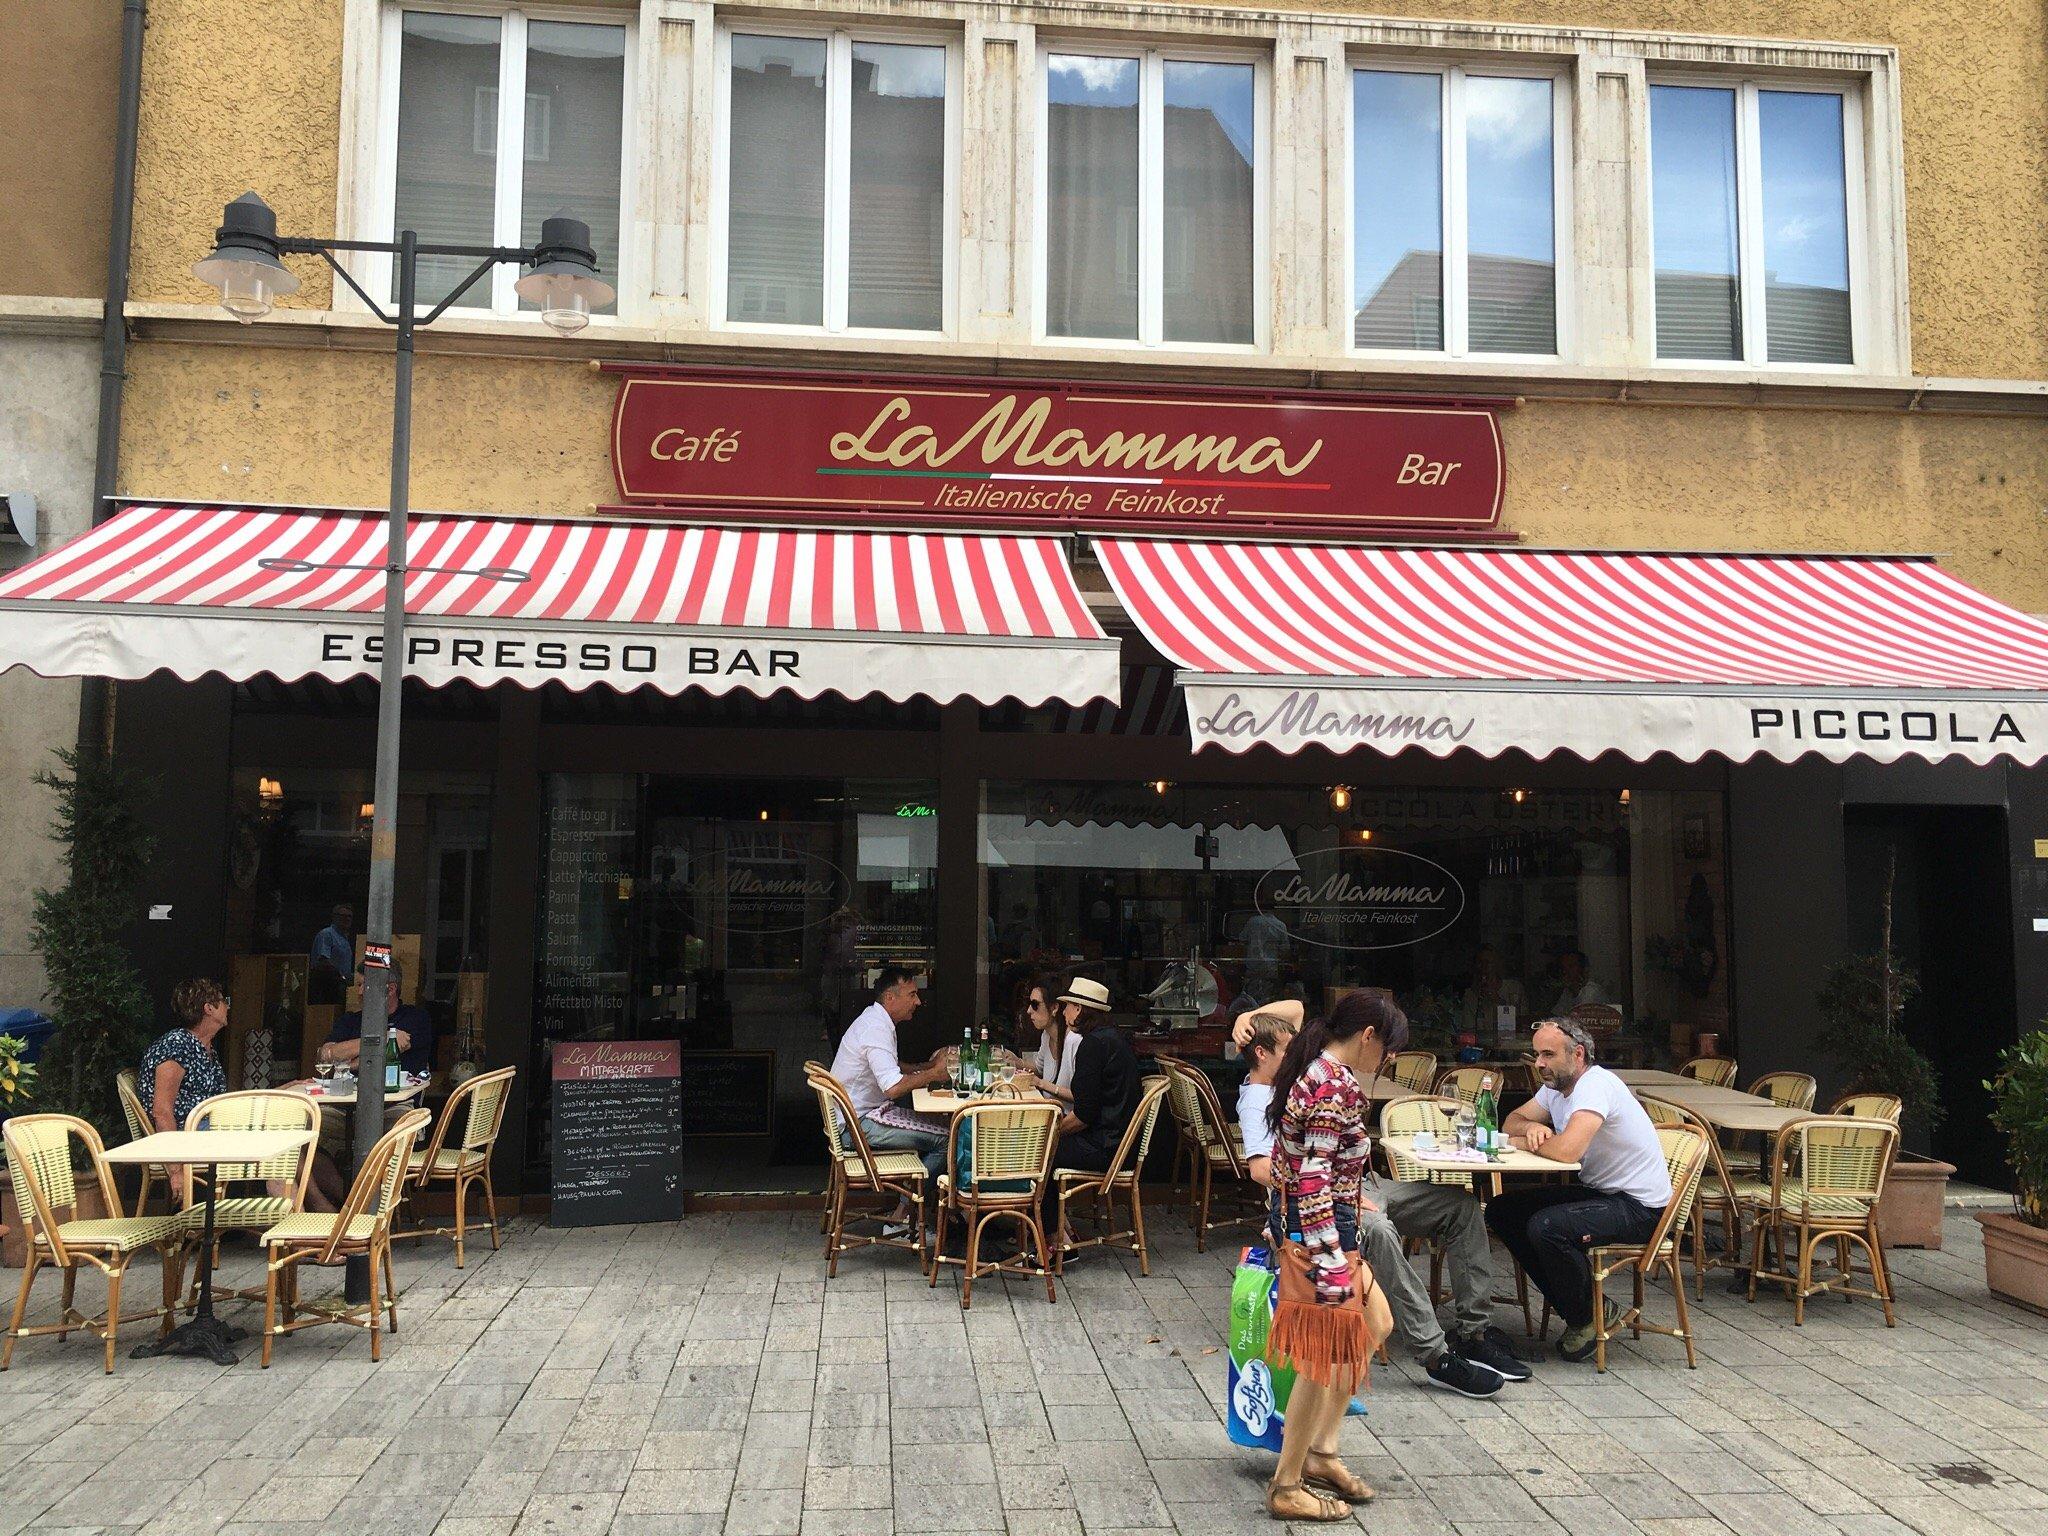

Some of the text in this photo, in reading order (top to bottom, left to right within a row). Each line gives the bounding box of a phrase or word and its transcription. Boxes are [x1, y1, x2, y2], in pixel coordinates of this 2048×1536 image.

[650, 427, 742, 462] Café
[1396, 453, 1461, 486] Bar
[933, 483, 1226, 516] Italienische Feinkost
[321, 633, 801, 678] ESPRESSO BAR
[1750, 708, 2027, 743] PICCOLA
[580, 809, 591, 821] to
[593, 811, 607, 825] go
[550, 827, 597, 844] Espresso
[549, 847, 608, 864] Cappuccino
[549, 869, 630, 885] Latte Macchiato
[548, 890, 580, 904] Panini
[547, 911, 576, 925] Pasta
[1302, 911, 1419, 925] Italienische Feinkost
[546, 931, 583, 946] Salumi
[546, 952, 595, 969] Formaggi
[545, 973, 600, 988] Alimentari
[544, 994, 624, 1009] Affettato Misto
[543, 1015, 564, 1030] Vini
[1237, 1329, 1247, 1351] Das
[1241, 1385, 1267, 1426] Soft
